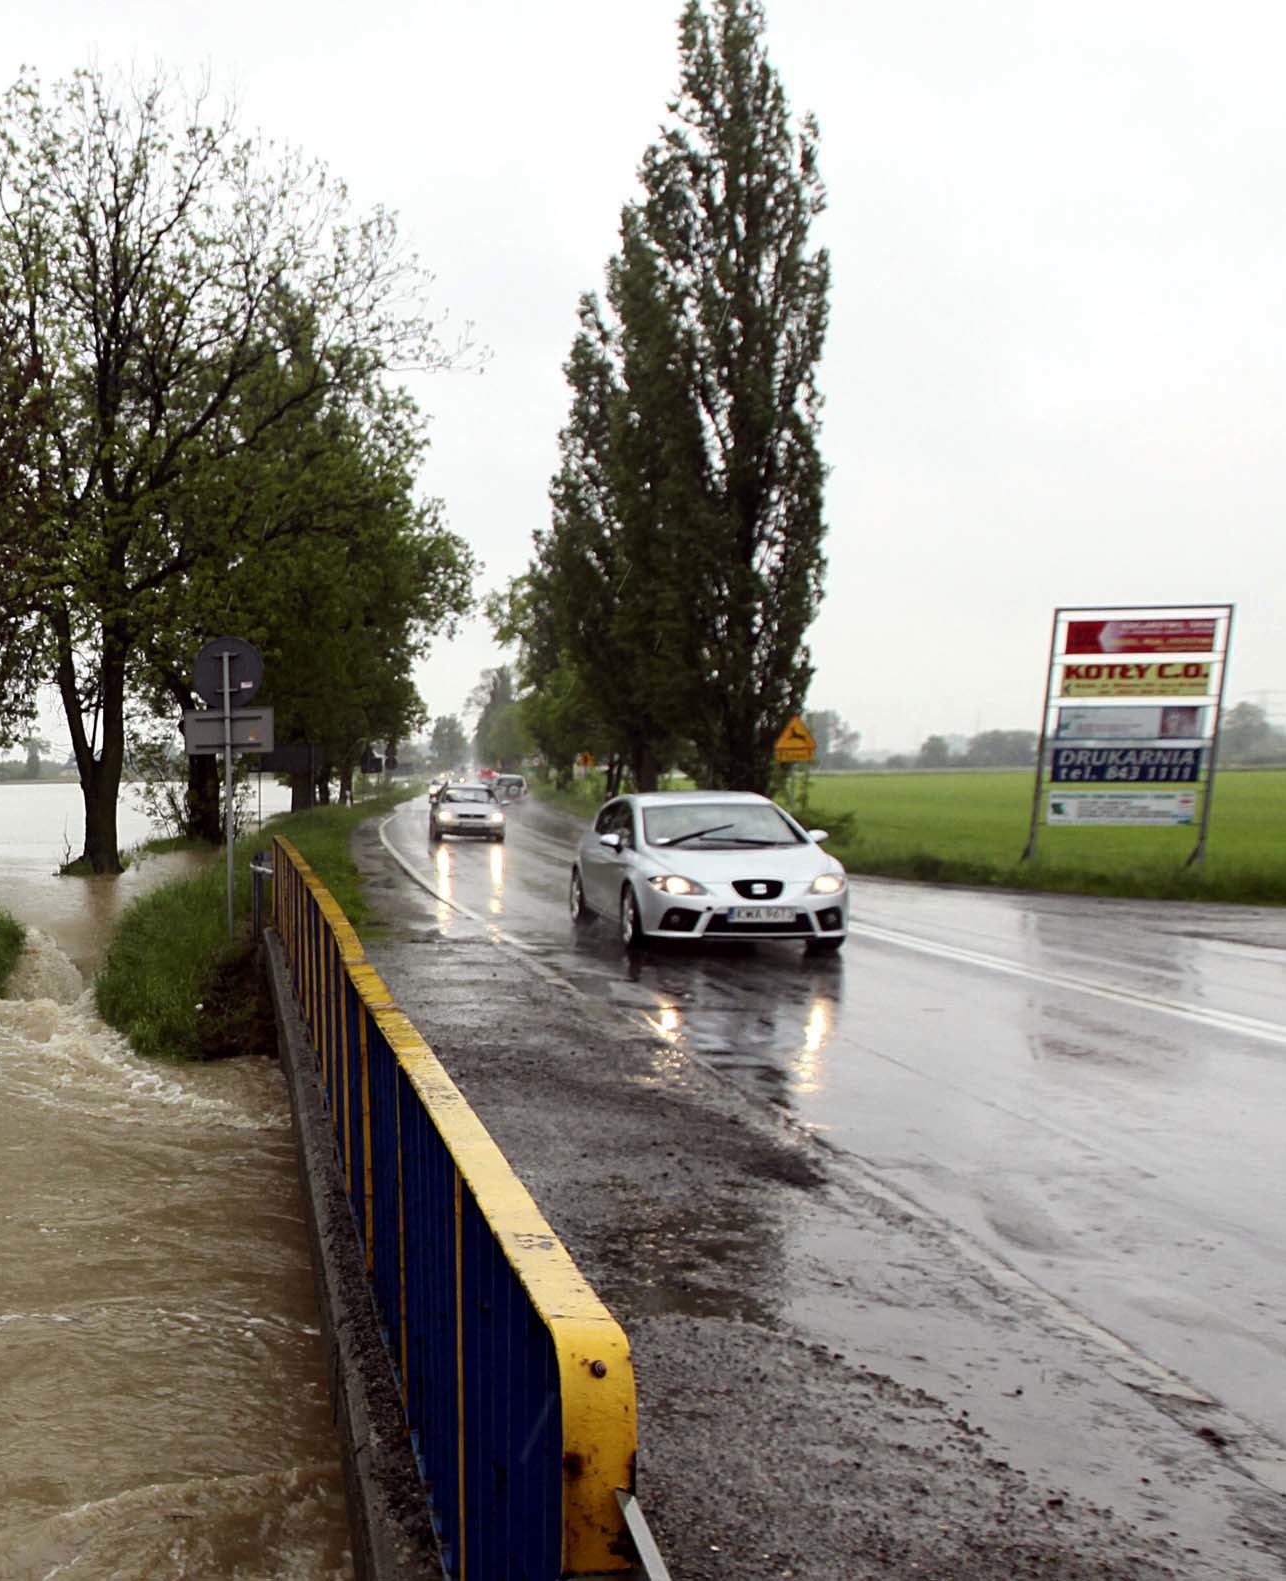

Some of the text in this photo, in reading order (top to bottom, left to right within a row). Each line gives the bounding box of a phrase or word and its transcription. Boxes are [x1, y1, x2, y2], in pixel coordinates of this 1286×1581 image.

[1065, 663, 1210, 680] KOTŁY C.O.
[1059, 750, 1195, 766] DRUKARNIA
[1060, 766, 1097, 780] tel.
[1148, 766, 1193, 780] 1111
